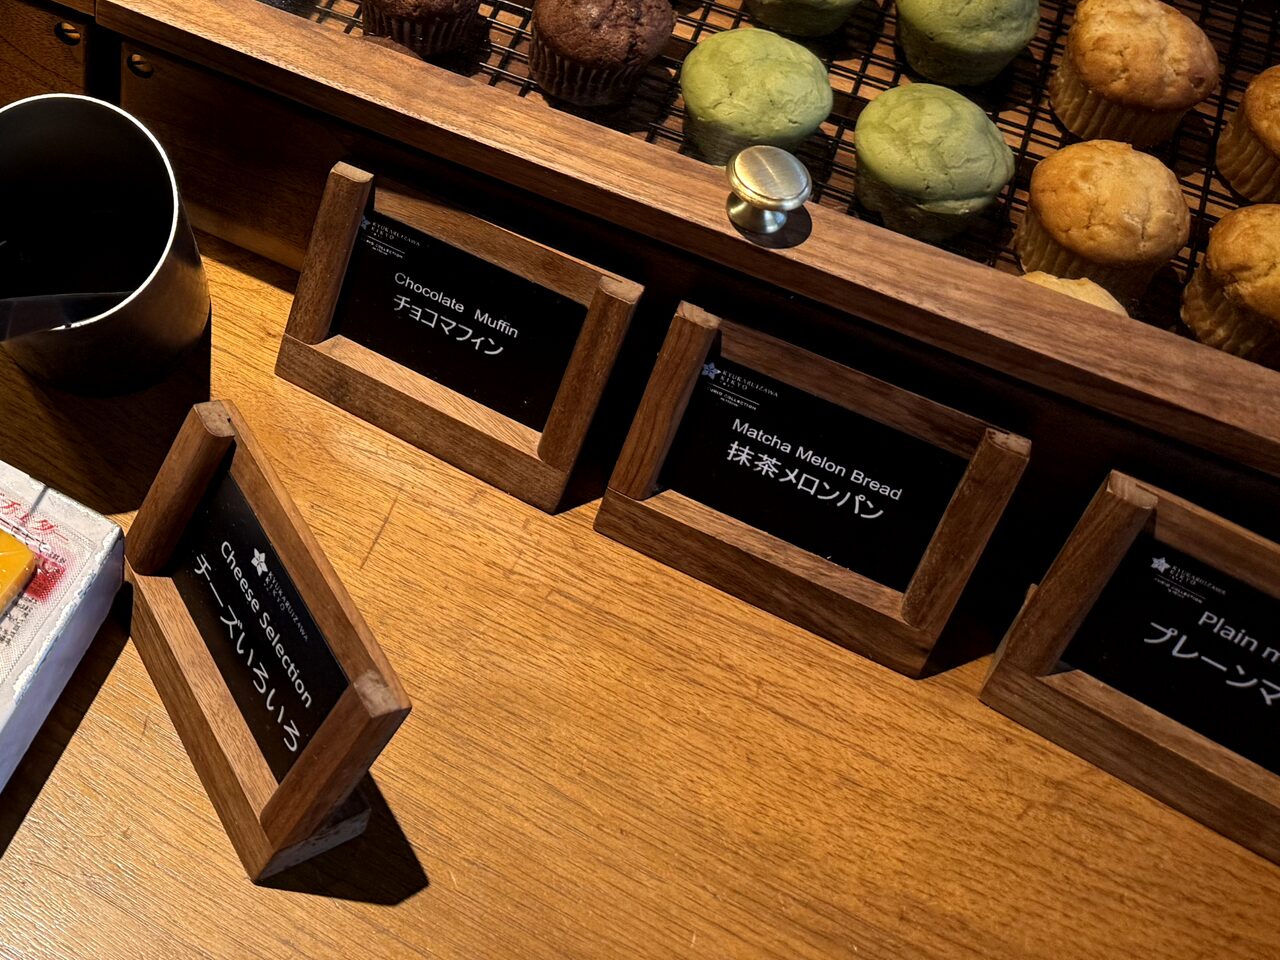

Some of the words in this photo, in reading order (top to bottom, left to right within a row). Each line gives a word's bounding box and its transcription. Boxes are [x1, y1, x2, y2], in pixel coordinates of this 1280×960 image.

[393, 294, 504, 355] チョコマフィン
[394, 272, 465, 314] Chocolate
[474, 308, 519, 339] Muffin
[726, 441, 884, 519] 抹茶メロンパン
[732, 418, 792, 454] Matcha
[795, 446, 847, 477] Melon
[850, 469, 903, 501] Bread
[194, 553, 300, 753] チーズいろいろ
[221, 540, 260, 614] Cheese
[259, 611, 313, 708] Selection
[1198, 611, 1258, 651] Plain
